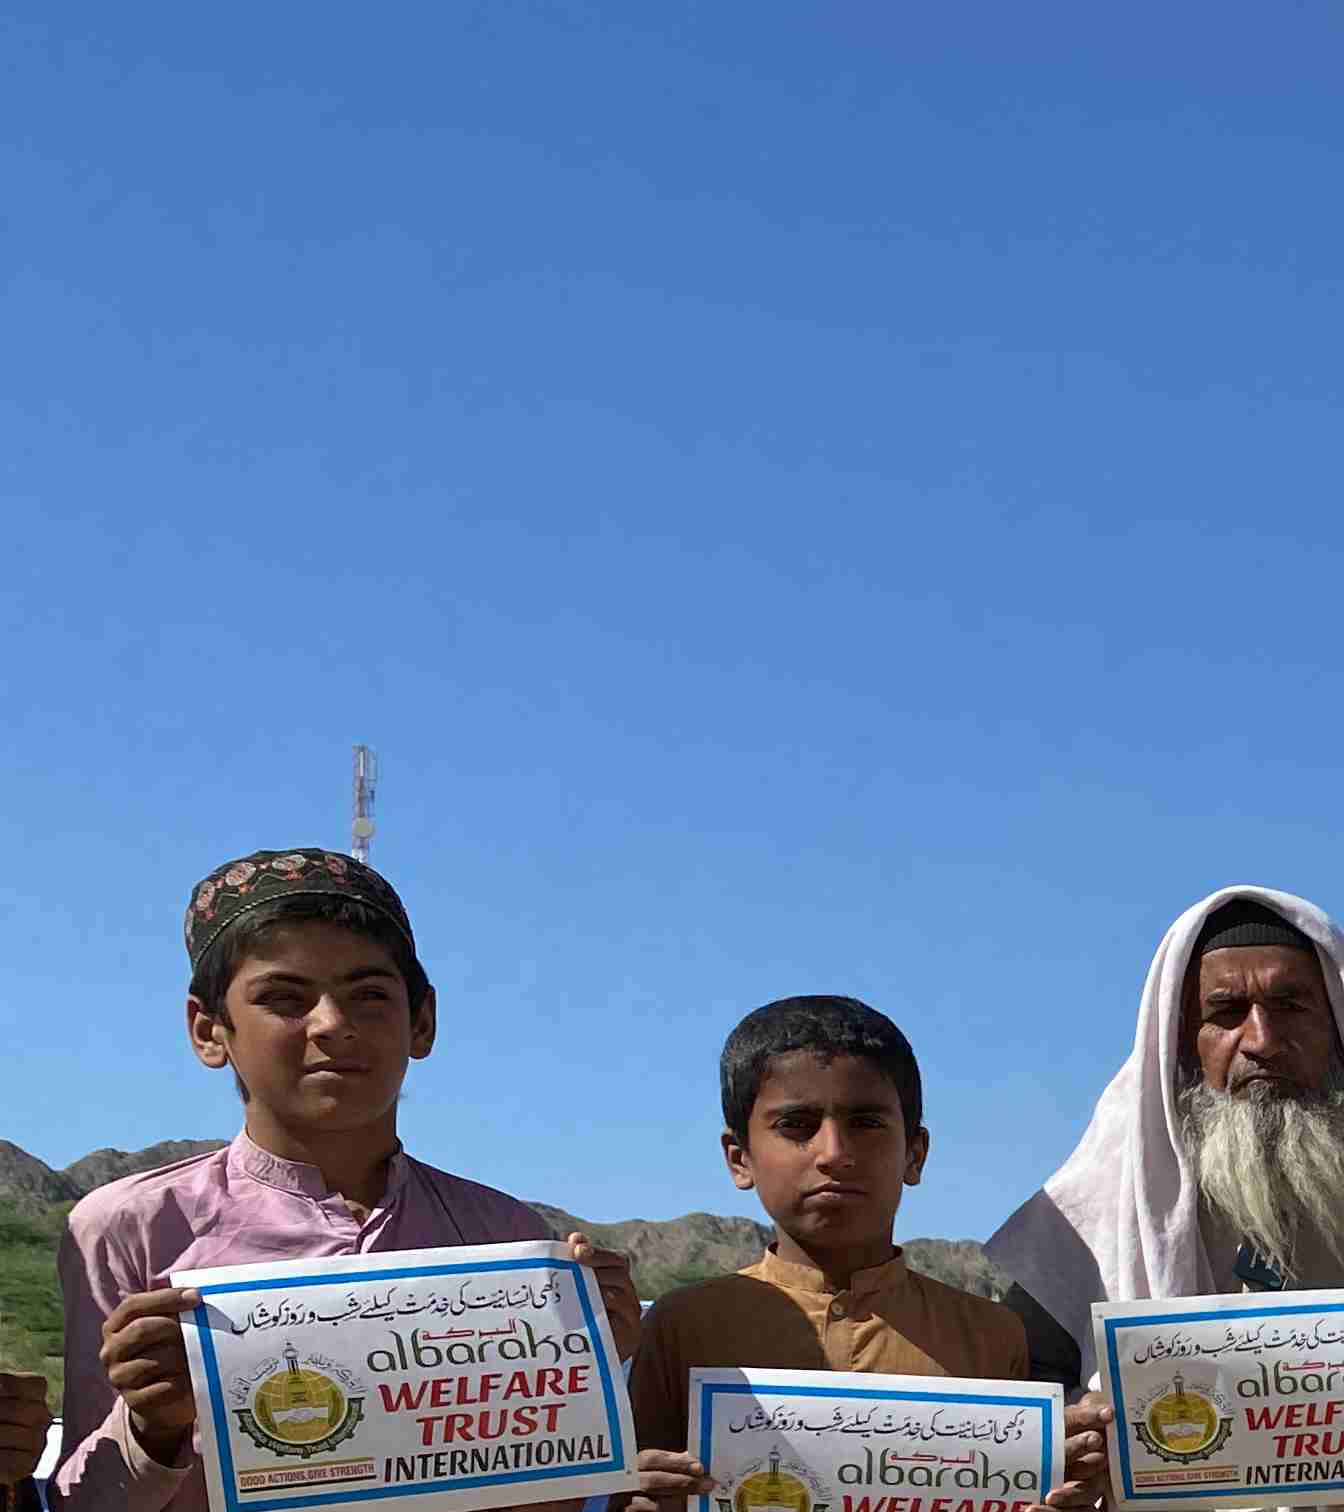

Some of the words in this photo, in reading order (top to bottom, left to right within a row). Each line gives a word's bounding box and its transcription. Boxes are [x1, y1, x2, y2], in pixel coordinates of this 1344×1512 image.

[366, 1319, 591, 1373] albaraka
[376, 1364, 590, 1413] WELFARE
[416, 1403, 566, 1447] TRUST
[330, 1463, 374, 1478] STRENGTH
[384, 1433, 610, 1484] INTERNATIONAL
[837, 1447, 1037, 1496] albaraka
